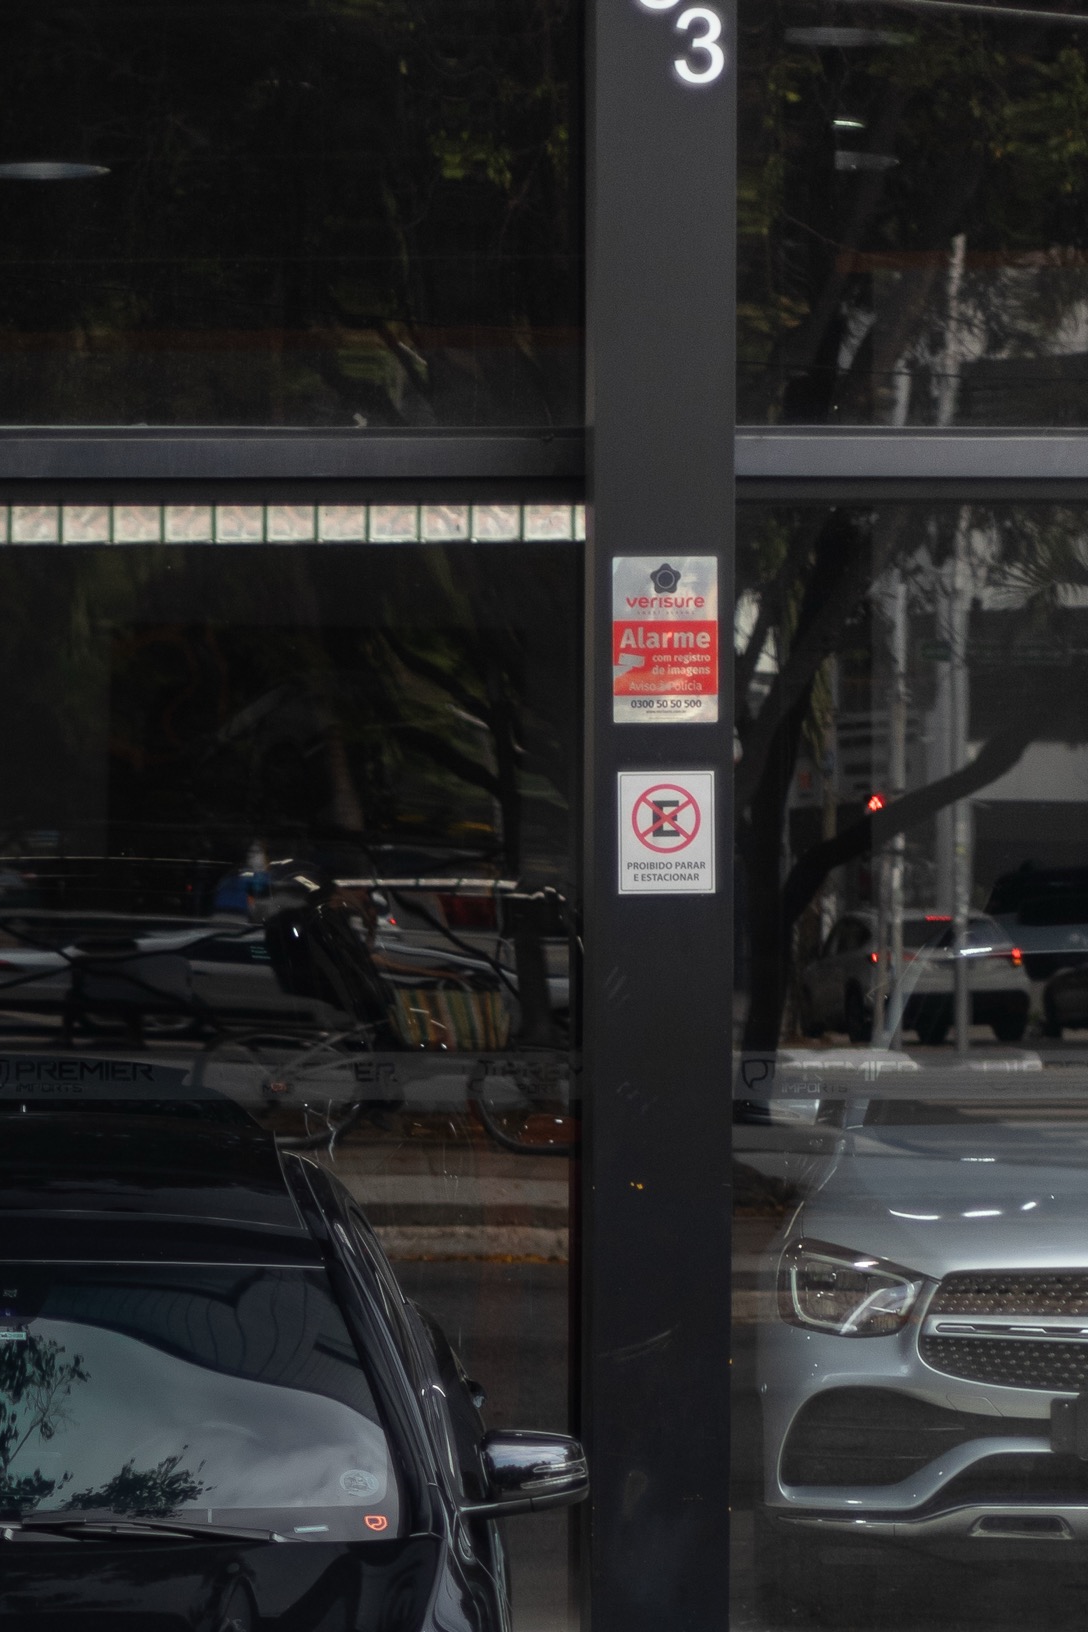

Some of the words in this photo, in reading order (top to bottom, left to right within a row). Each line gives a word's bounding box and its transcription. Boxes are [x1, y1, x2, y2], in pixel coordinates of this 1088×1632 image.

[674, 7, 725, 84] 3
[625, 595, 705, 609] verisure
[620, 626, 711, 649] Alarme
[652, 654, 672, 662] com
[674, 652, 711, 664] registro
[652, 664, 665, 675] de
[667, 664, 711, 677] imagens
[629, 680, 656, 691] Aviso
[630, 699, 655, 709] 0300
[656, 699, 668, 709] 50
[670, 699, 682, 709] 50
[684, 699, 702, 709] 500
[626, 861, 673, 871] PROIBIDO
[674, 861, 706, 870] PARAR
[633, 873, 640, 882] E
[641, 872, 700, 882] ESTACIONAR
[15, 1061, 155, 1082] PREMIER
